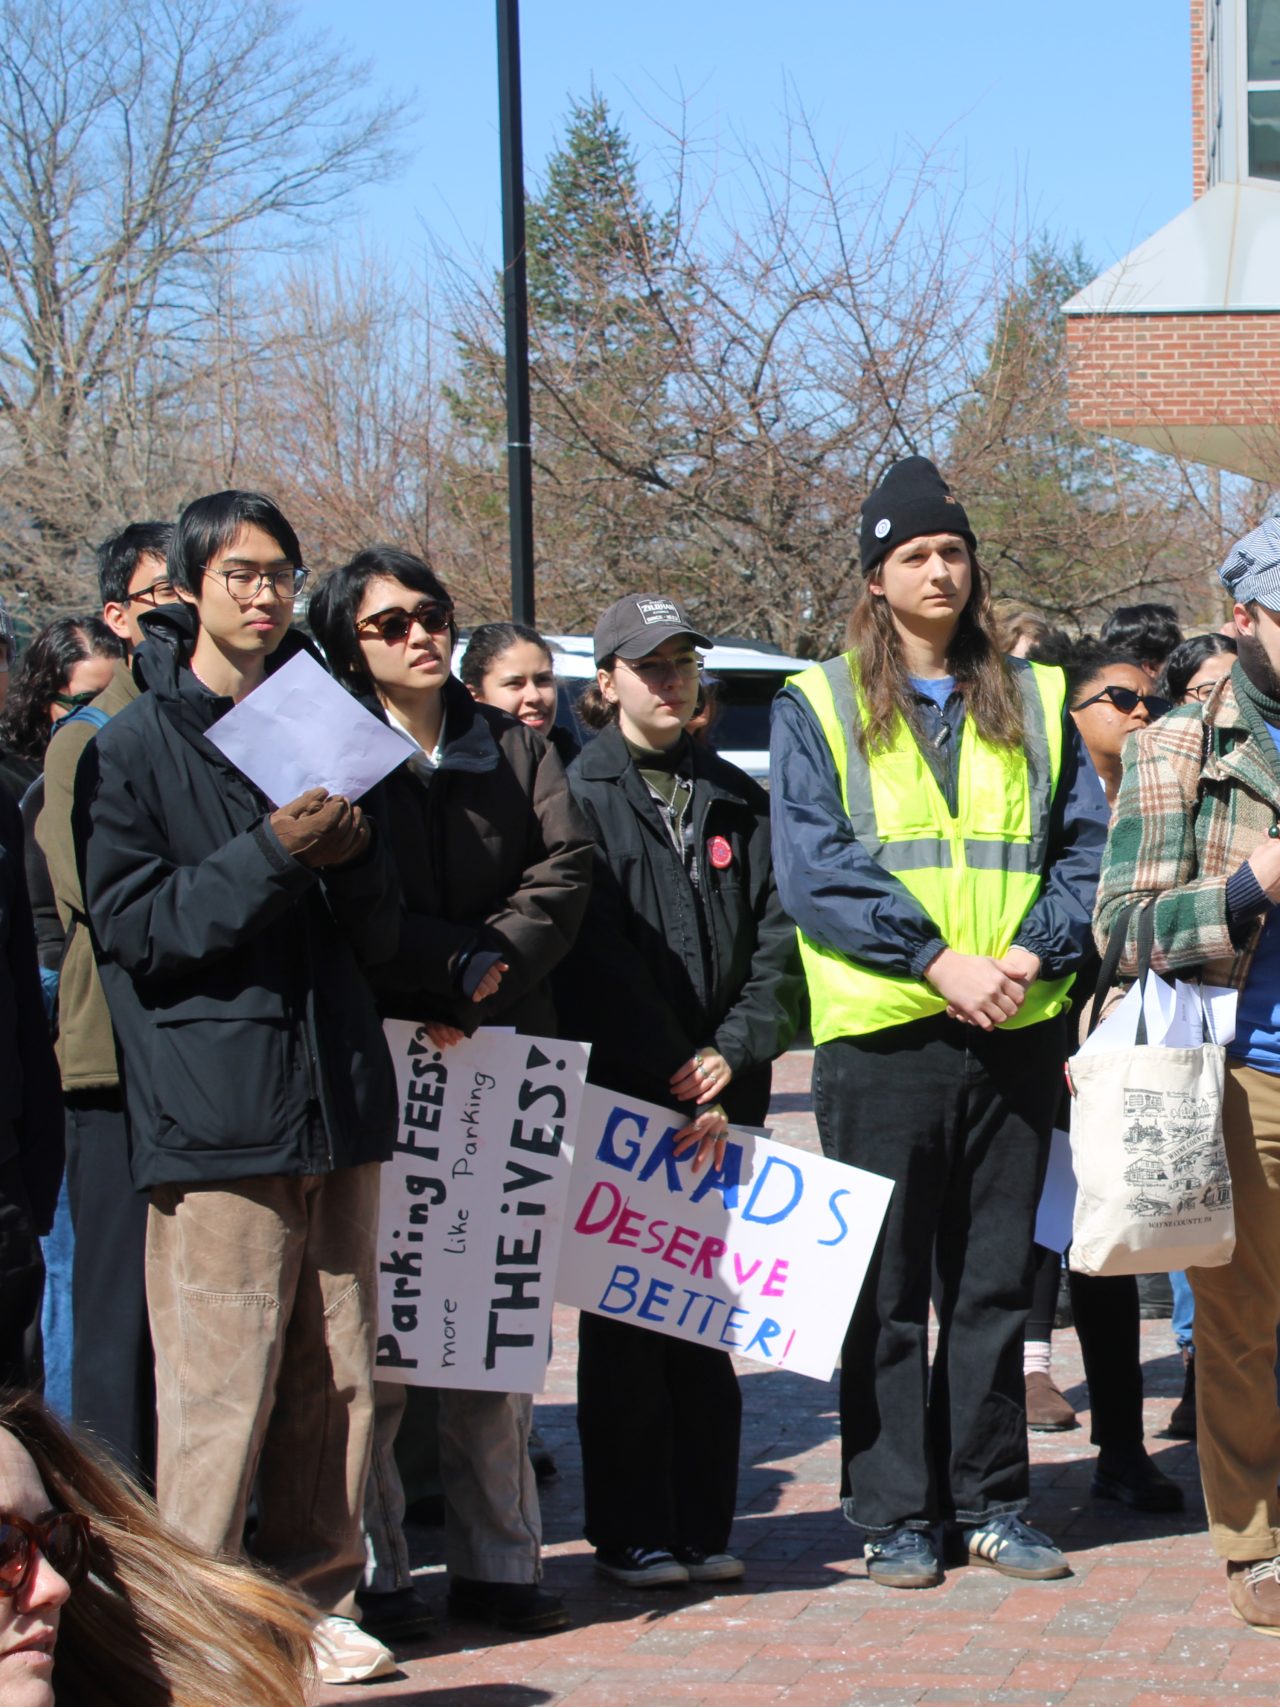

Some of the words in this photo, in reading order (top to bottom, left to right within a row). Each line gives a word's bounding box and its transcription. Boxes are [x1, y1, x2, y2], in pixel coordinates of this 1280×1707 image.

[452, 1071, 496, 1180] Parking
[1167, 1145, 1186, 1161] WAYNE
[1186, 1133, 1210, 1148] COUNTY
[443, 1207, 470, 1255] Like
[573, 1181, 790, 1297] DESERVE
[1149, 1220, 1173, 1228] WAYNE
[375, 1174, 448, 1370] Parking
[598, 1264, 797, 1366] BETTER!
[441, 1298, 458, 1368] more
